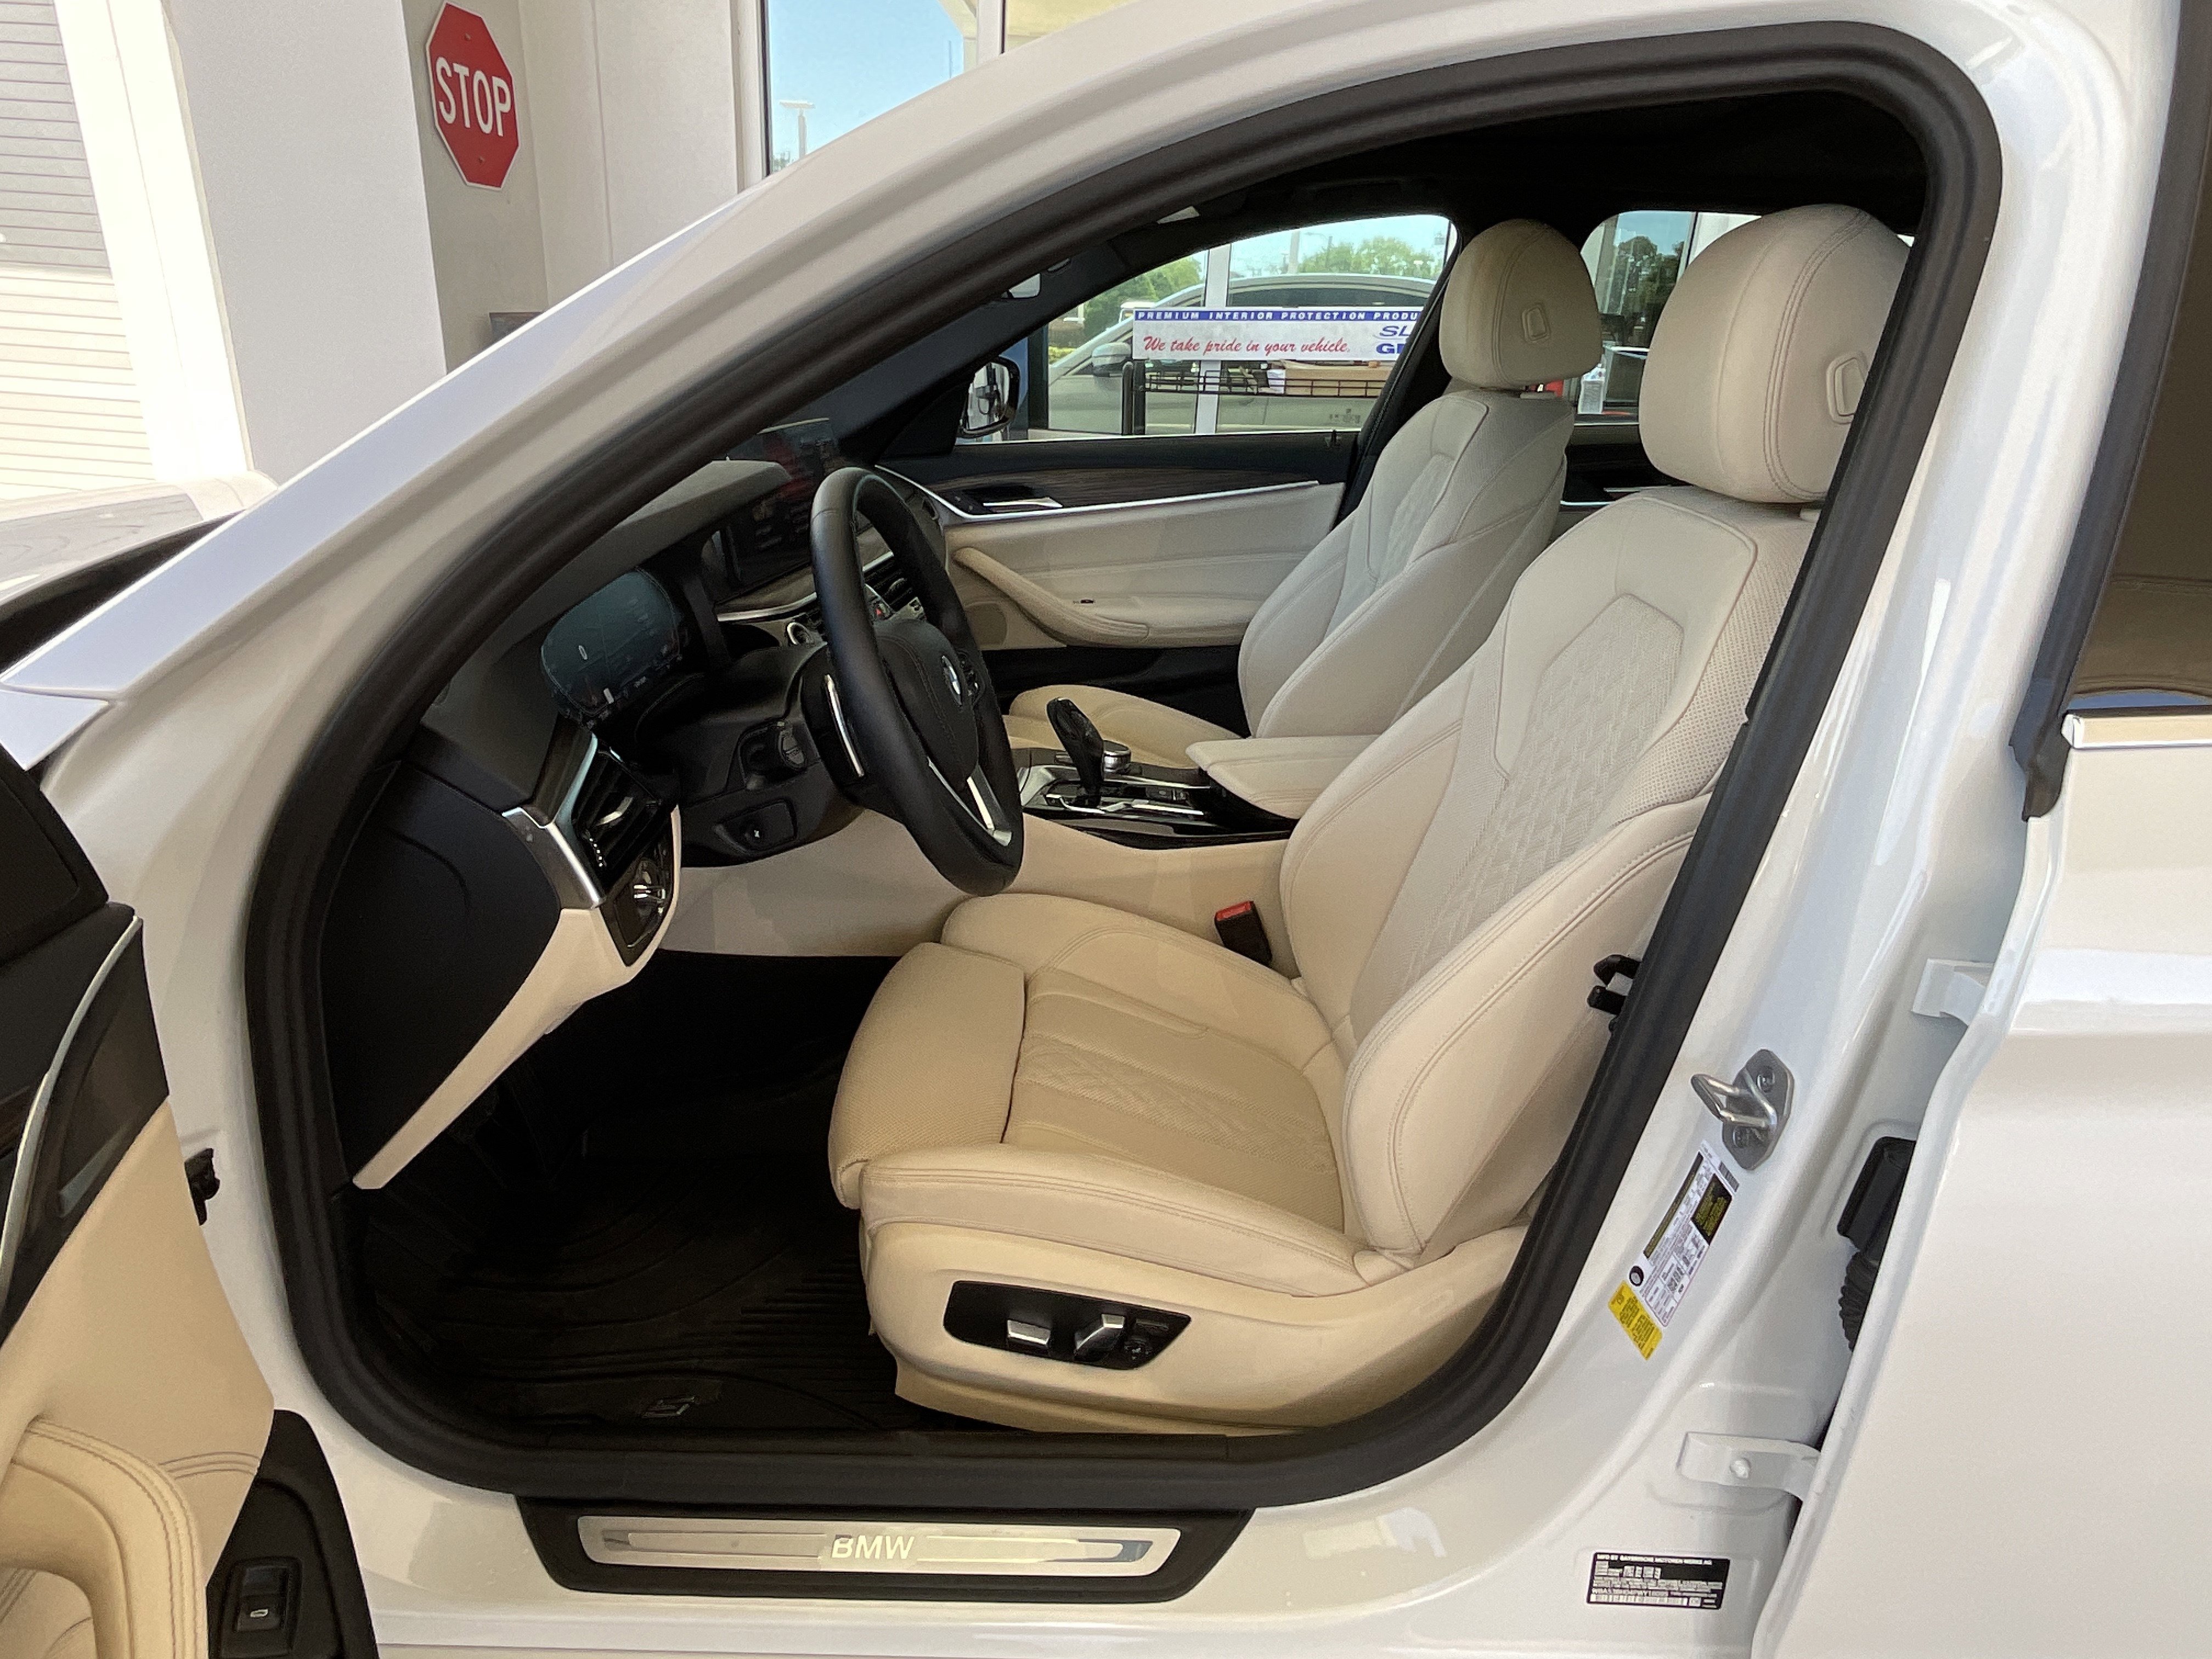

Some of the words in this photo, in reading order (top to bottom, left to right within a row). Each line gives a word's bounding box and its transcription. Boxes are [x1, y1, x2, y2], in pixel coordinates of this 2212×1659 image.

[436, 56, 511, 137] STOP
[1138, 312, 1200, 320] PREMIUM
[1209, 312, 1273, 320] INTERIOR
[1280, 312, 1366, 320] PROTECTION
[1143, 335, 1166, 352] We
[1170, 336, 1200, 352] take
[1203, 337, 1243, 357] pride
[1246, 340, 1260, 352] in
[1263, 342, 1297, 357] your
[1300, 336, 1351, 353] vehicle.
[831, 1534, 916, 1559] BMW
